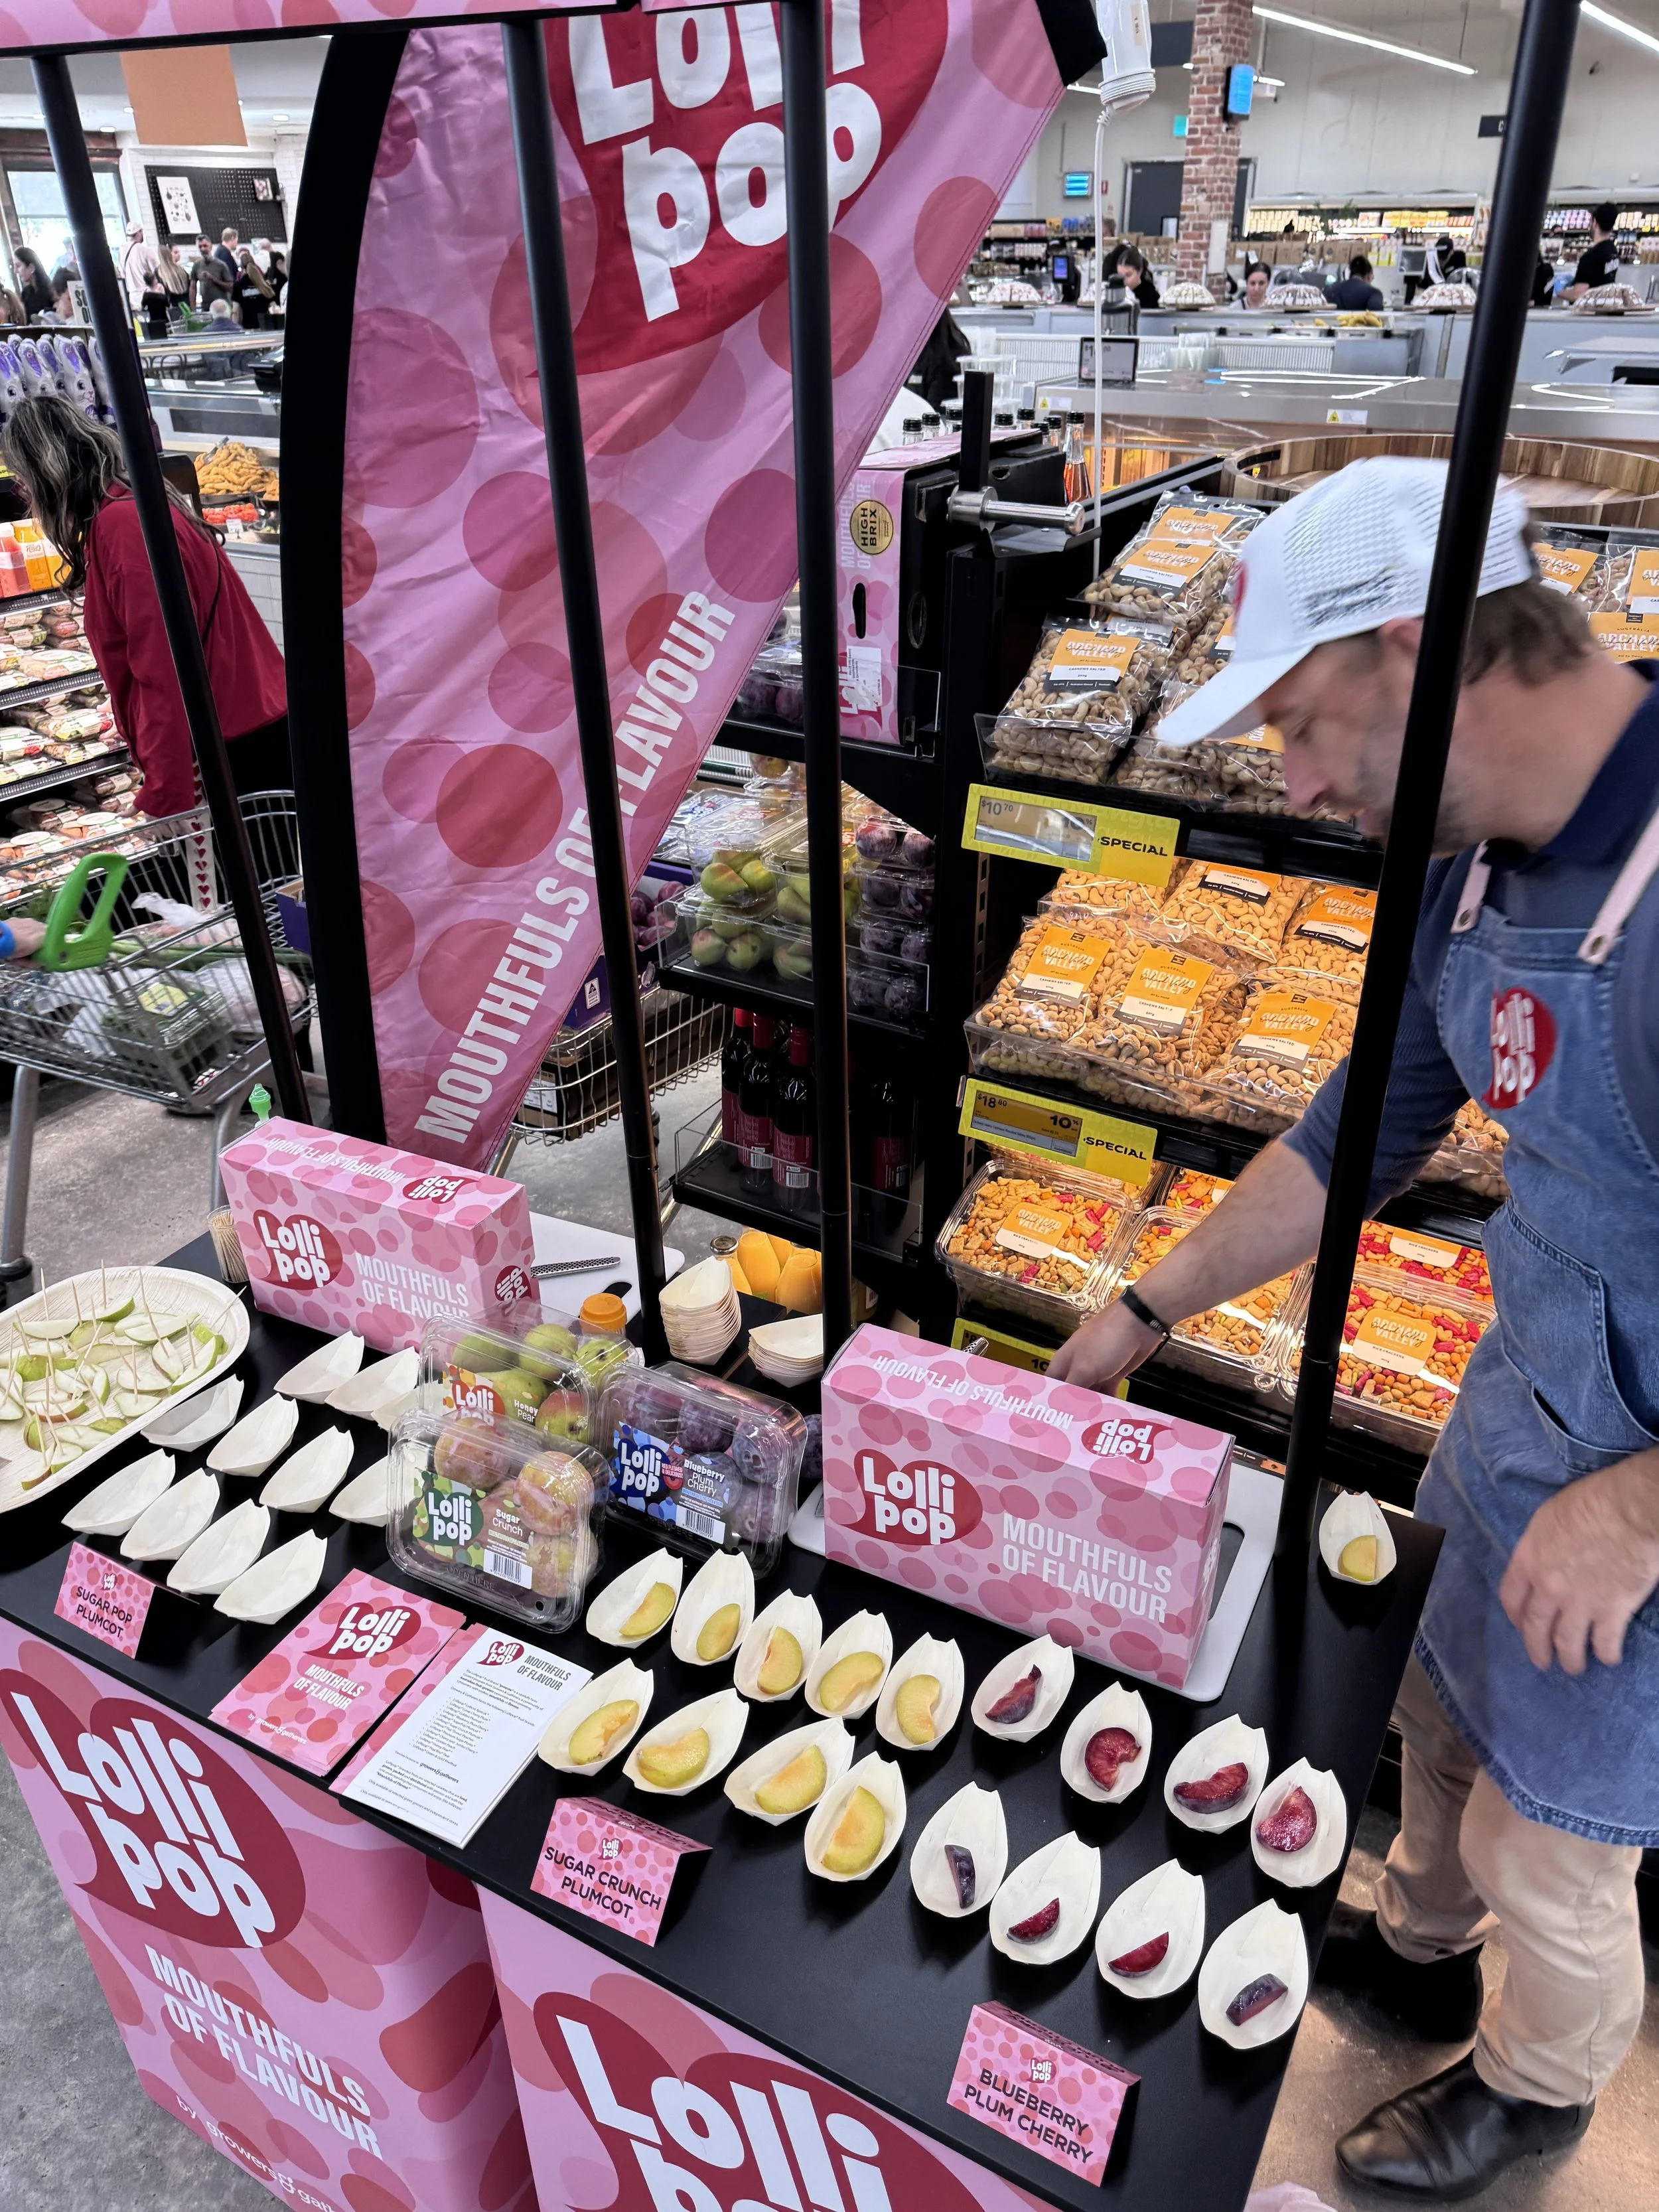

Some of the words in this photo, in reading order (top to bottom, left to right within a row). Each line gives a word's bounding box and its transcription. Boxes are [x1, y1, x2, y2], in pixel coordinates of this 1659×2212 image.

[1598, 633, 1659, 642] ORCHAR
[1071, 649, 1116, 658] VALLEY
[1100, 836, 1168, 857] SPECIAL
[1043, 945, 1094, 964] ORCHARD
[1045, 956, 1082, 972] VALLEY
[1141, 968, 1196, 988] ORCHARD
[1144, 980, 1185, 995] VALLEY
[414, 877, 590, 1144] MOUTHFULS
[1265, 1021, 1307, 1030] VALLEY
[264, 1138, 321, 1160] FLAVOUR
[314, 1149, 336, 1164] OF
[1085, 1137, 1147, 1160] SPECIAL
[332, 1156, 406, 1183] MOUTHFULS
[257, 1216, 326, 1259] Lolli
[1019, 1219, 1049, 1234] VALLEY
[274, 1248, 331, 1288] pop
[354, 1252, 469, 1307] MOUTHFULS
[362, 1281, 385, 1306] OF
[1373, 1317, 1428, 1340] ORCHARD
[1375, 1329, 1415, 1347] VALLEY
[873, 1355, 947, 1390] FLAVOUR
[455, 1384, 494, 1412] Lolli
[944, 1378, 970, 1396] OF
[514, 1400, 538, 1416] Honey
[518, 1410, 535, 1422] Pear
[970, 1385, 1074, 1430] MOUTHFULS
[1102, 1418, 1153, 1442] pop
[1094, 1432, 1153, 1461] Lolli
[620, 1443, 662, 1477] Lolli
[684, 1459, 725, 1483] Blueberry
[621, 1466, 660, 1497] pop
[687, 1479, 717, 1497] Cherry
[692, 1472, 713, 1487] Plum
[861, 1456, 956, 1515] Lolli
[428, 1492, 472, 1524] Lolli
[496, 1509, 520, 1524] Sugar
[873, 1495, 956, 1546] pop
[433, 1515, 472, 1546] pop
[492, 1518, 523, 1537] Crunch
[1003, 1514, 1173, 1594] MOUTHFULS
[1002, 1543, 1037, 1576] OF
[1043, 1560, 1168, 1624] FLAVOUR
[76, 1586, 111, 1612] SUGAR
[111, 1605, 133, 1623] POP
[76, 1604, 123, 1637] PLUMCOT
[338, 1606, 411, 1637] Lolli
[329, 1629, 394, 1659] pop
[490, 1641, 519, 1656] Lolli
[486, 1652, 514, 1665] pop
[524, 1654, 572, 1681] MOUTHFULS
[305, 1664, 365, 1698] MOUTHFULS
[516, 1665, 532, 1677] OF
[527, 1668, 563, 1691] FLAVOUR
[293, 1676, 313, 1691] OF
[309, 1684, 353, 1711] FLAVOUR
[248, 1713, 256, 1722] by
[9, 1692, 244, 1862] Lolli
[603, 1838, 619, 1851] Lolli
[603, 1848, 618, 1859] pop
[86, 1803, 276, 1949] pop
[544, 1846, 596, 1880] SUGAR
[599, 1872, 662, 1910] CRUNCH
[561, 1876, 633, 1919] PLUMCOT
[144, 1943, 372, 2117] MOUTHFULS
[163, 1991, 209, 2044] OF
[216, 2030, 384, 2162] FLAVOUR
[1031, 2059, 1052, 2073] Lolli
[1032, 2071, 1051, 2083] pop
[177, 2095, 196, 2119] by
[555, 2014, 893, 2212] Lolli
[979, 2068, 1089, 2137] BLUEBERRY
[964, 2085, 1013, 2122] PLUM
[1017, 2114, 1094, 2164] CHERRY
